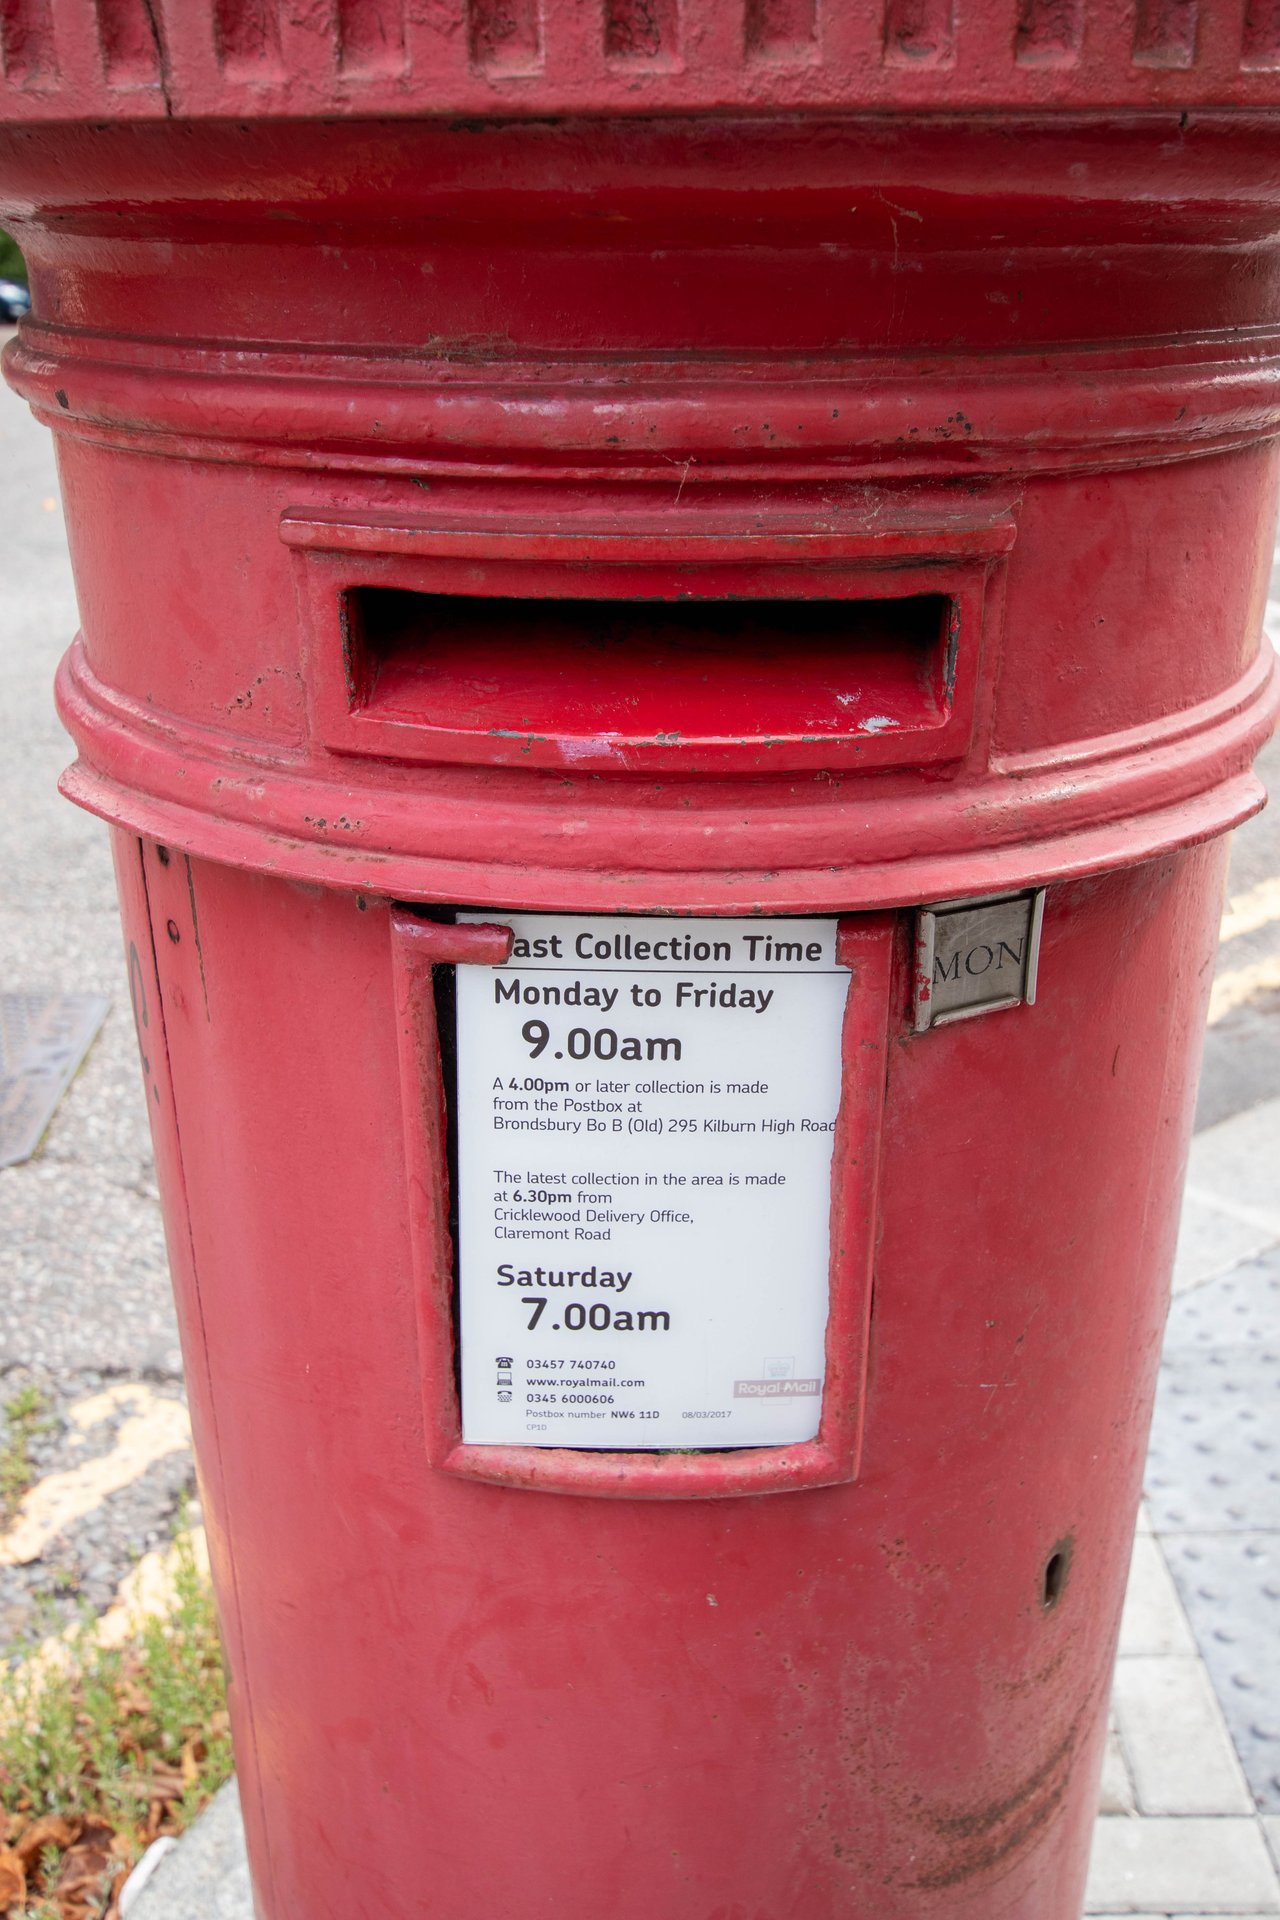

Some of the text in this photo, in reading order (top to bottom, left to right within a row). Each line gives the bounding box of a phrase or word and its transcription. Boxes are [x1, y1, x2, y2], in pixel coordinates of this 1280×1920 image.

[509, 933, 822, 961] ast Collection Time
[933, 938, 1024, 984] MON
[495, 978, 774, 1013] Monday to Friday
[522, 1020, 681, 1061] 9.00am
[493, 1077, 768, 1094] A 4.00pm or later collection is made
[493, 1097, 642, 1112] from the Postbox at
[494, 1116, 837, 1135] Brondsbury Bo B (Old) 295 Kilburn High Road
[493, 1171, 785, 1185] The latest collection in the area is made
[494, 1190, 612, 1205] at 6.30pm from
[495, 1208, 693, 1225] Cricklewood Delivery Office,
[495, 1226, 610, 1240] Claremont Road
[497, 1264, 632, 1292] Saturday
[521, 1297, 670, 1331] 7.00am
[527, 1360, 615, 1369] 03457 740740
[527, 1378, 644, 1388] www.royalmail.com
[738, 1381, 817, 1396] Royal Mail
[527, 1394, 614, 1404] 0345 6000606
[526, 1409, 564, 1417] Postbox
